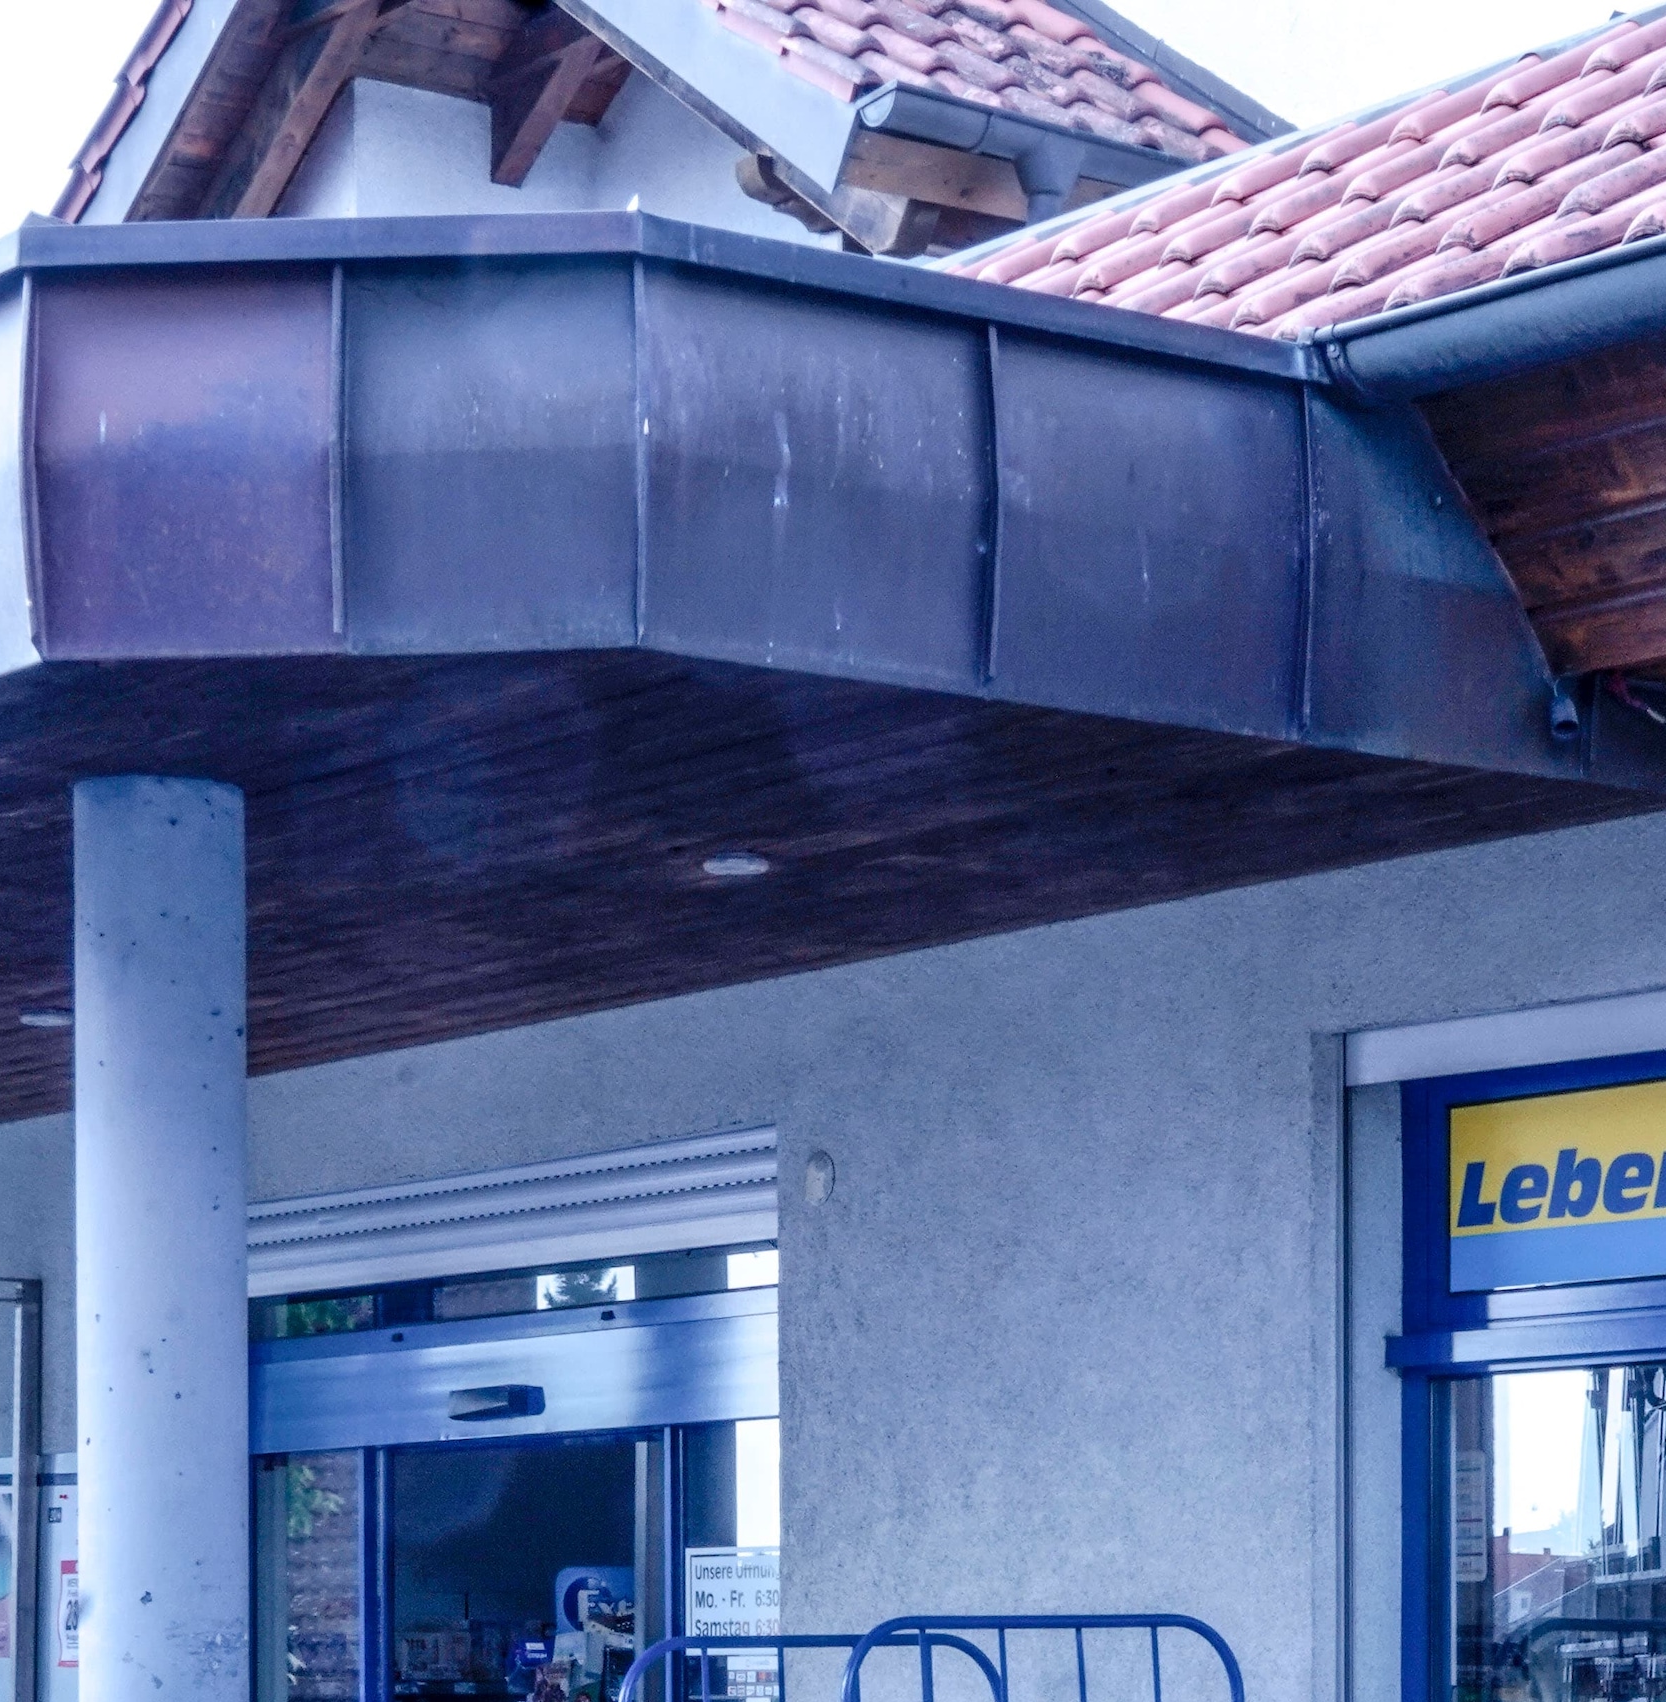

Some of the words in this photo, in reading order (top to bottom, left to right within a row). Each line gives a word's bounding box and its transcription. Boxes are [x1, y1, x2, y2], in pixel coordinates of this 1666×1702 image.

[694, 1564, 733, 1580] Unsere
[694, 1590, 718, 1608] Mo.
[730, 1590, 746, 1608] Fr.
[694, 1619, 751, 1637] Samstag
